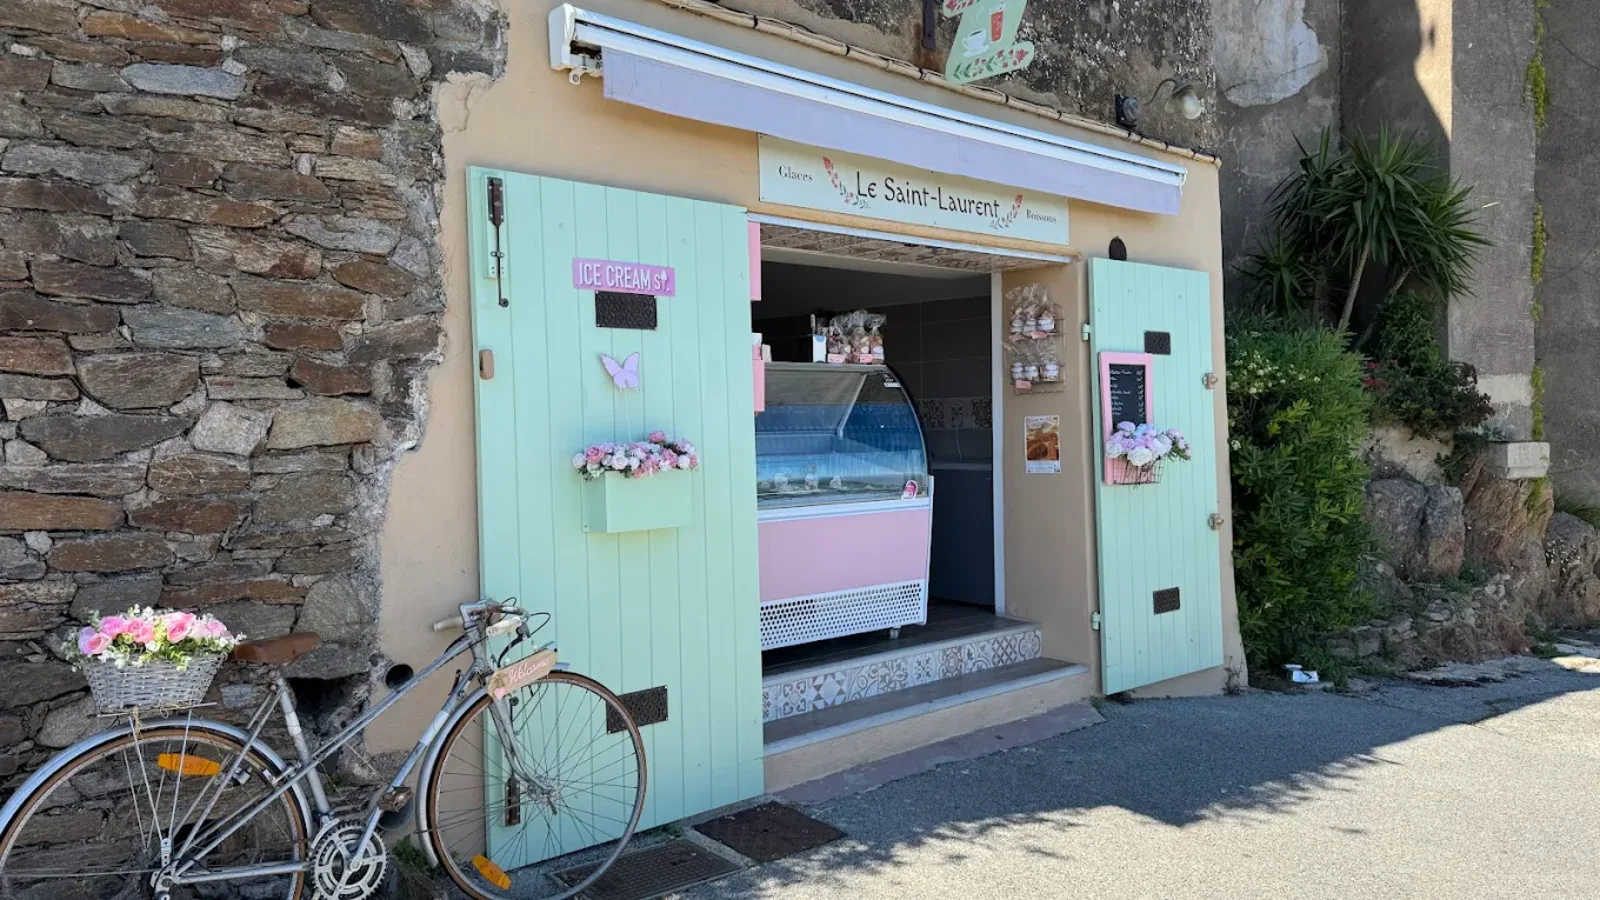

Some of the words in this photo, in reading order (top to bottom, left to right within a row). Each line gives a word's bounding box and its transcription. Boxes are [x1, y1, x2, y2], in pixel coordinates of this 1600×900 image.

[779, 165, 813, 182] Glaces
[857, 171, 877, 198] Le
[884, 177, 1000, 218] Saint-Laurent
[579, 262, 602, 286] ICE
[606, 265, 651, 290] CREAM
[508, 659, 549, 684] Welcome
